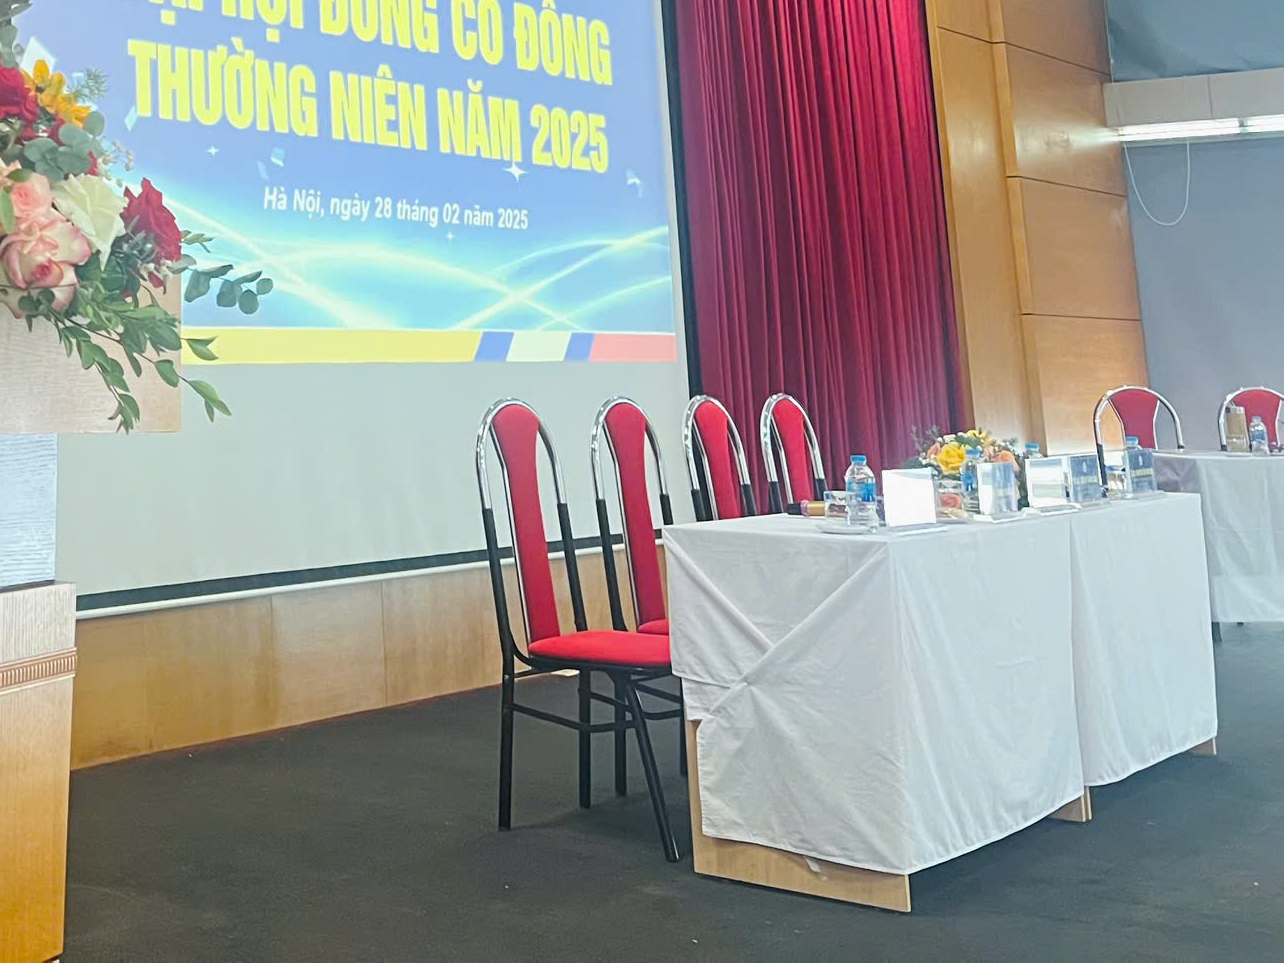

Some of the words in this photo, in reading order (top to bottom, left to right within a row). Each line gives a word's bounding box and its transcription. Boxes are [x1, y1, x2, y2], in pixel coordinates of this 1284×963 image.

[127, 36, 319, 138] THƯỜNG
[329, 63, 428, 151] NIÊN
[436, 78, 522, 163] NĂM
[529, 103, 609, 174] 2025
[263, 186, 287, 211] Hà
[292, 188, 325, 219] Nội,
[329, 193, 370, 222] ngày
[374, 196, 392, 219] 28
[396, 198, 439, 228] tháng
[442, 203, 460, 225] 02
[463, 204, 494, 227] năm
[497, 208, 529, 230] 2025
